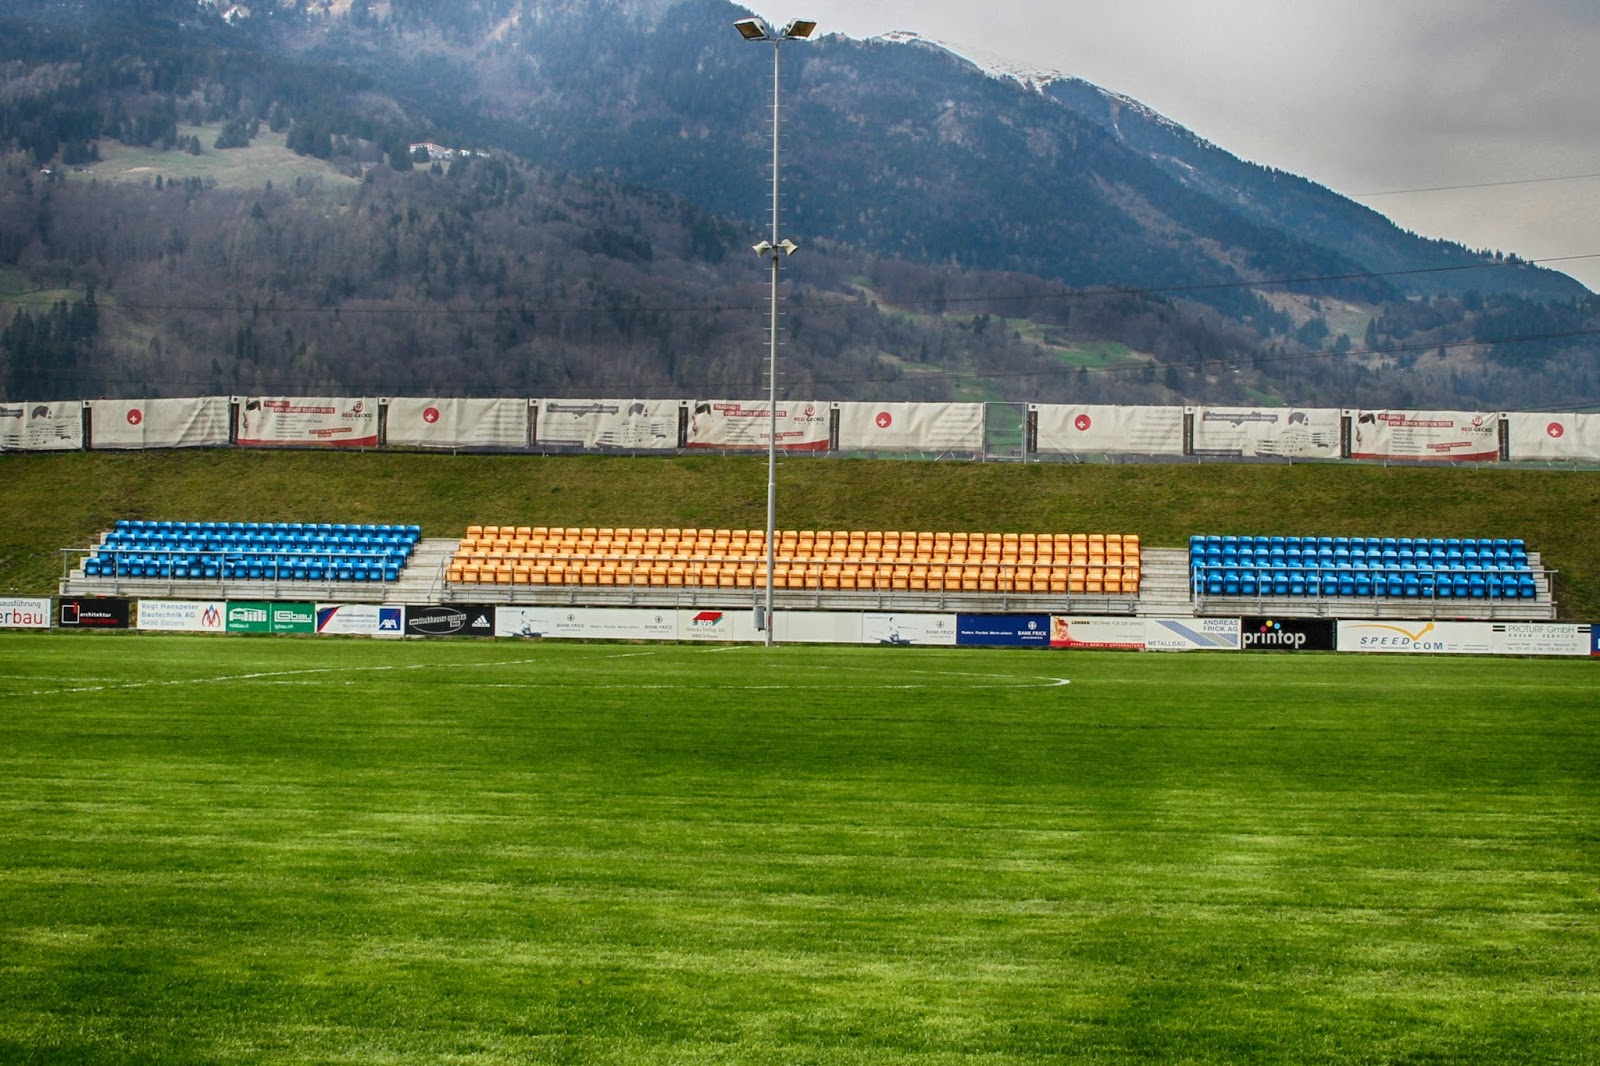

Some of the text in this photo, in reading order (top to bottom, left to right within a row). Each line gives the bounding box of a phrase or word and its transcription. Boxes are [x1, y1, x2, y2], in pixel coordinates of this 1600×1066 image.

[379, 619, 397, 629] AXA
[1508, 625, 1574, 633] PROTURF GmbH
[1243, 629, 1306, 649] printop
[1360, 636, 1410, 645] SPEED
[1413, 642, 1443, 650] COM
